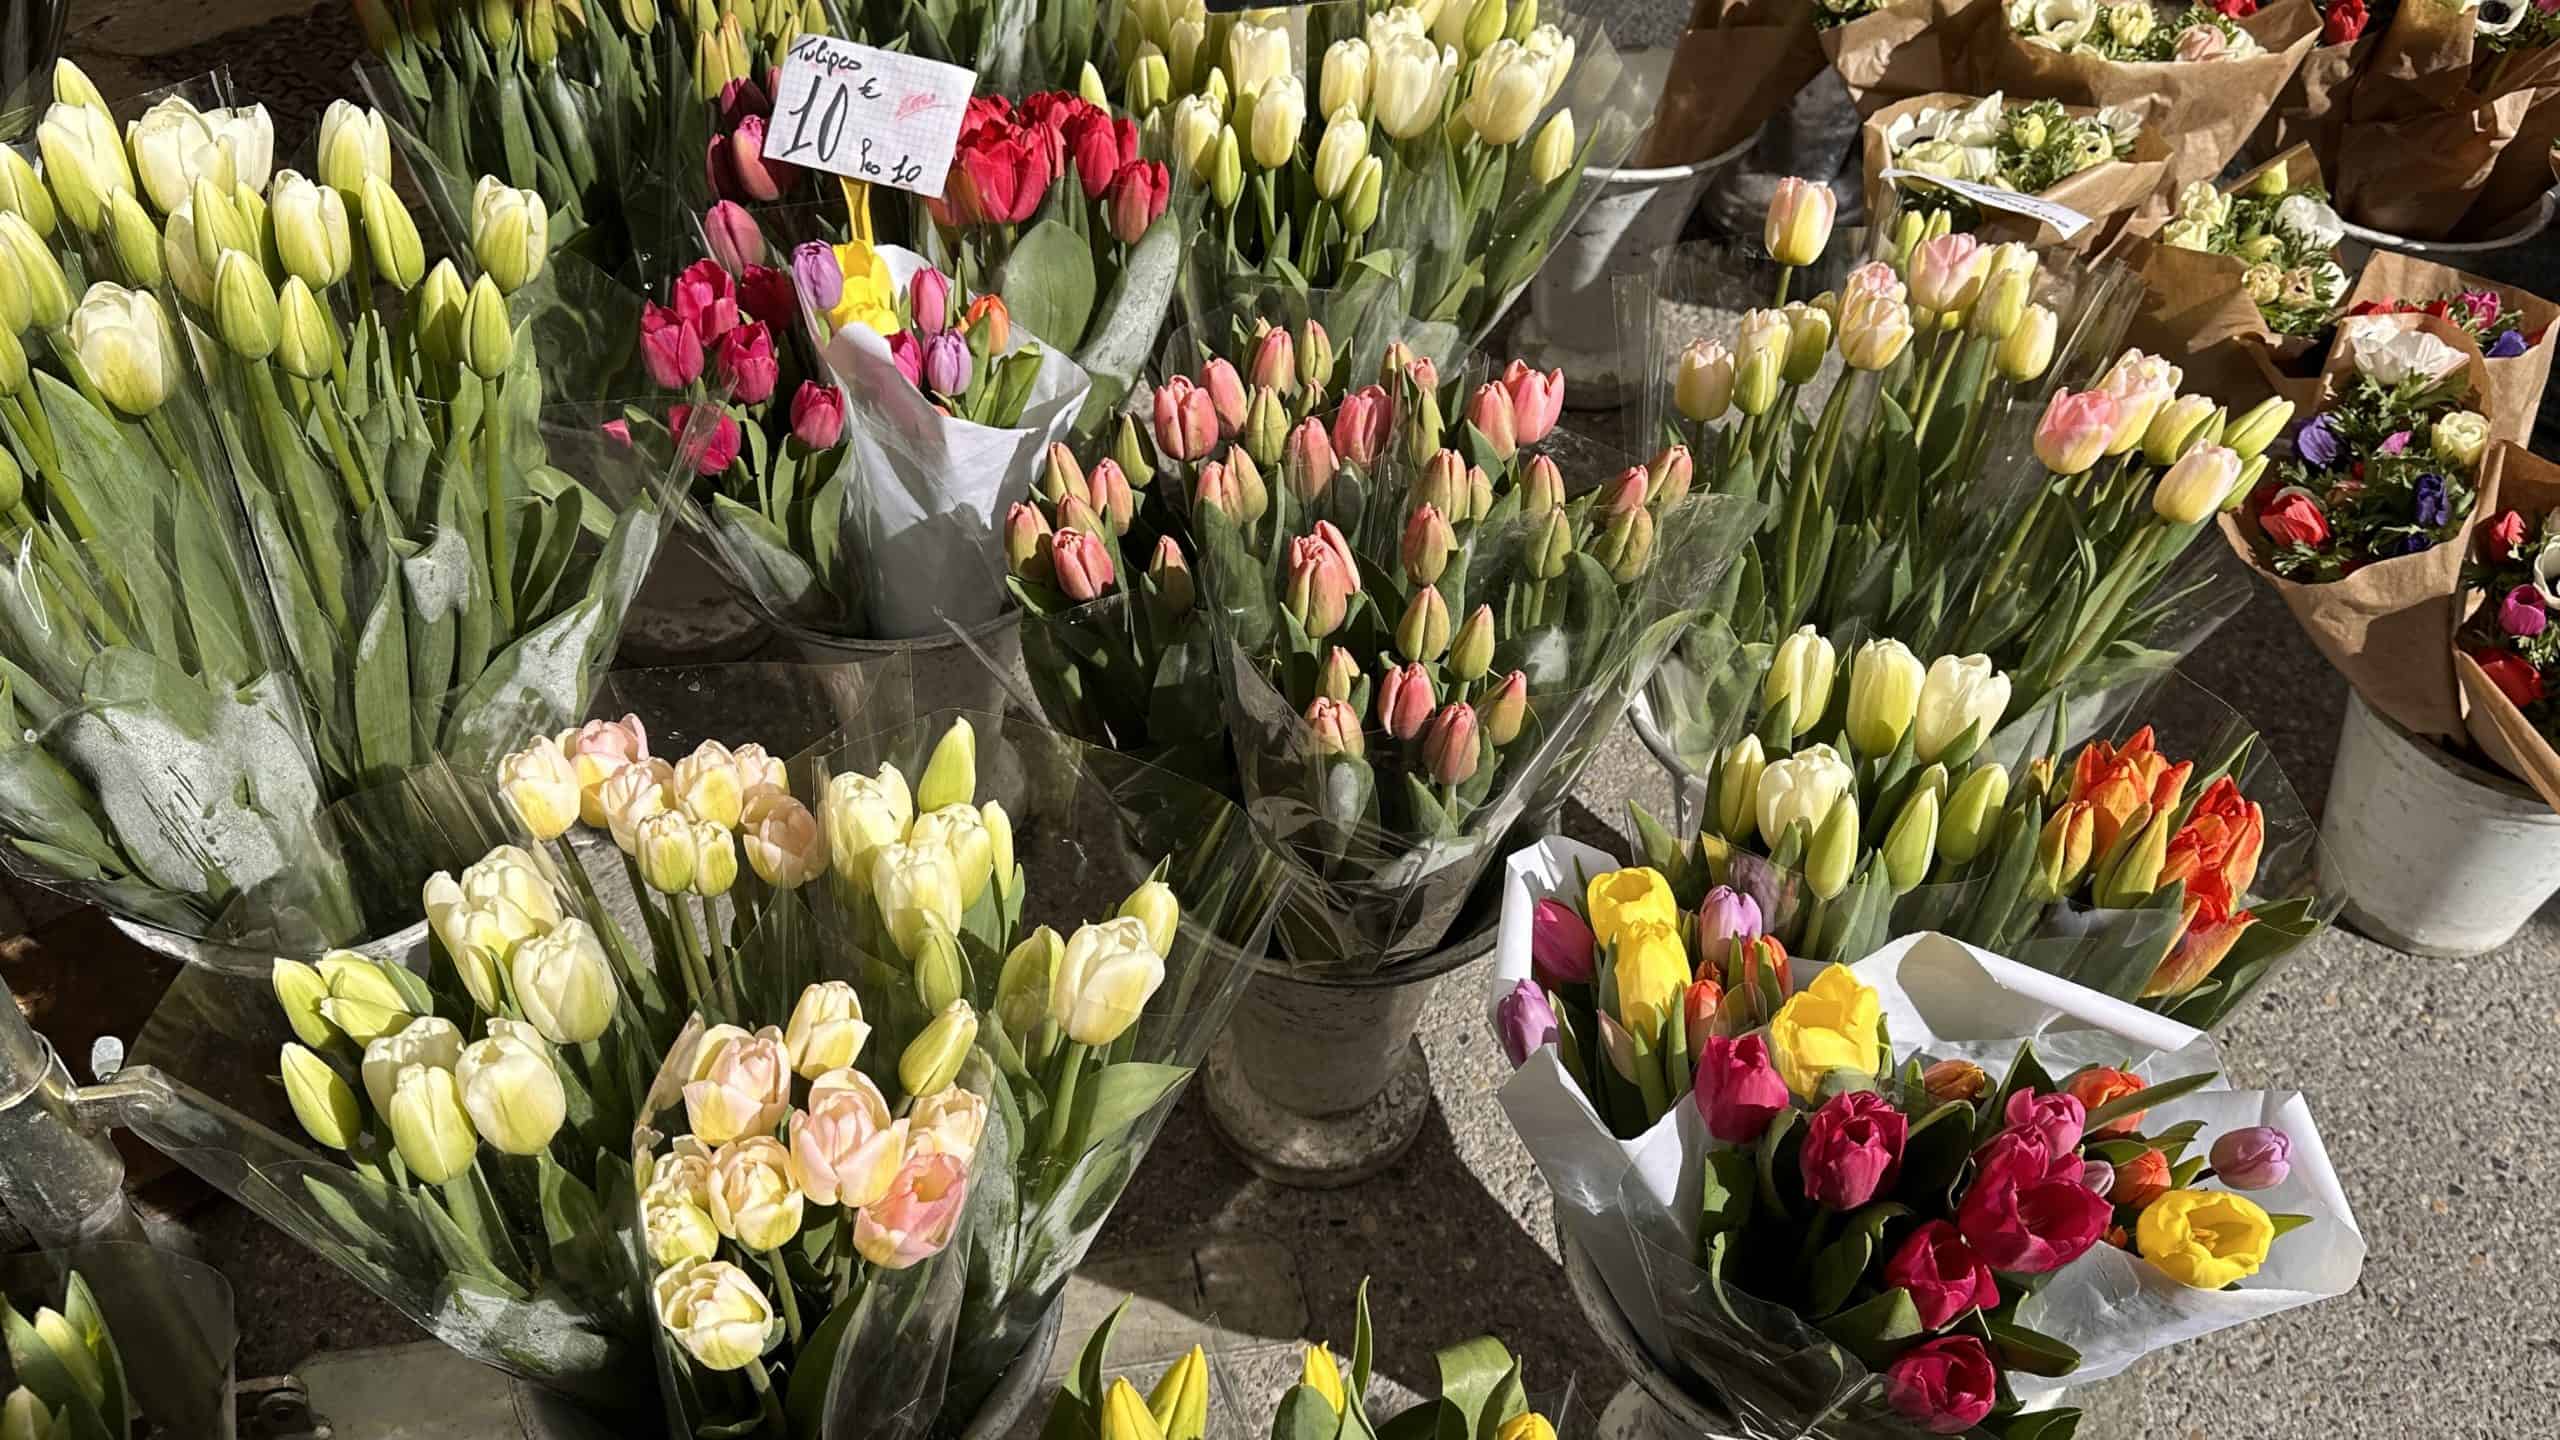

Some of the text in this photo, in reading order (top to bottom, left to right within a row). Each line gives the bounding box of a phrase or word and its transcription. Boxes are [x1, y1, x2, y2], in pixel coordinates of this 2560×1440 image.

[782, 75, 881, 162] 10 €
[892, 155, 921, 184] 10
